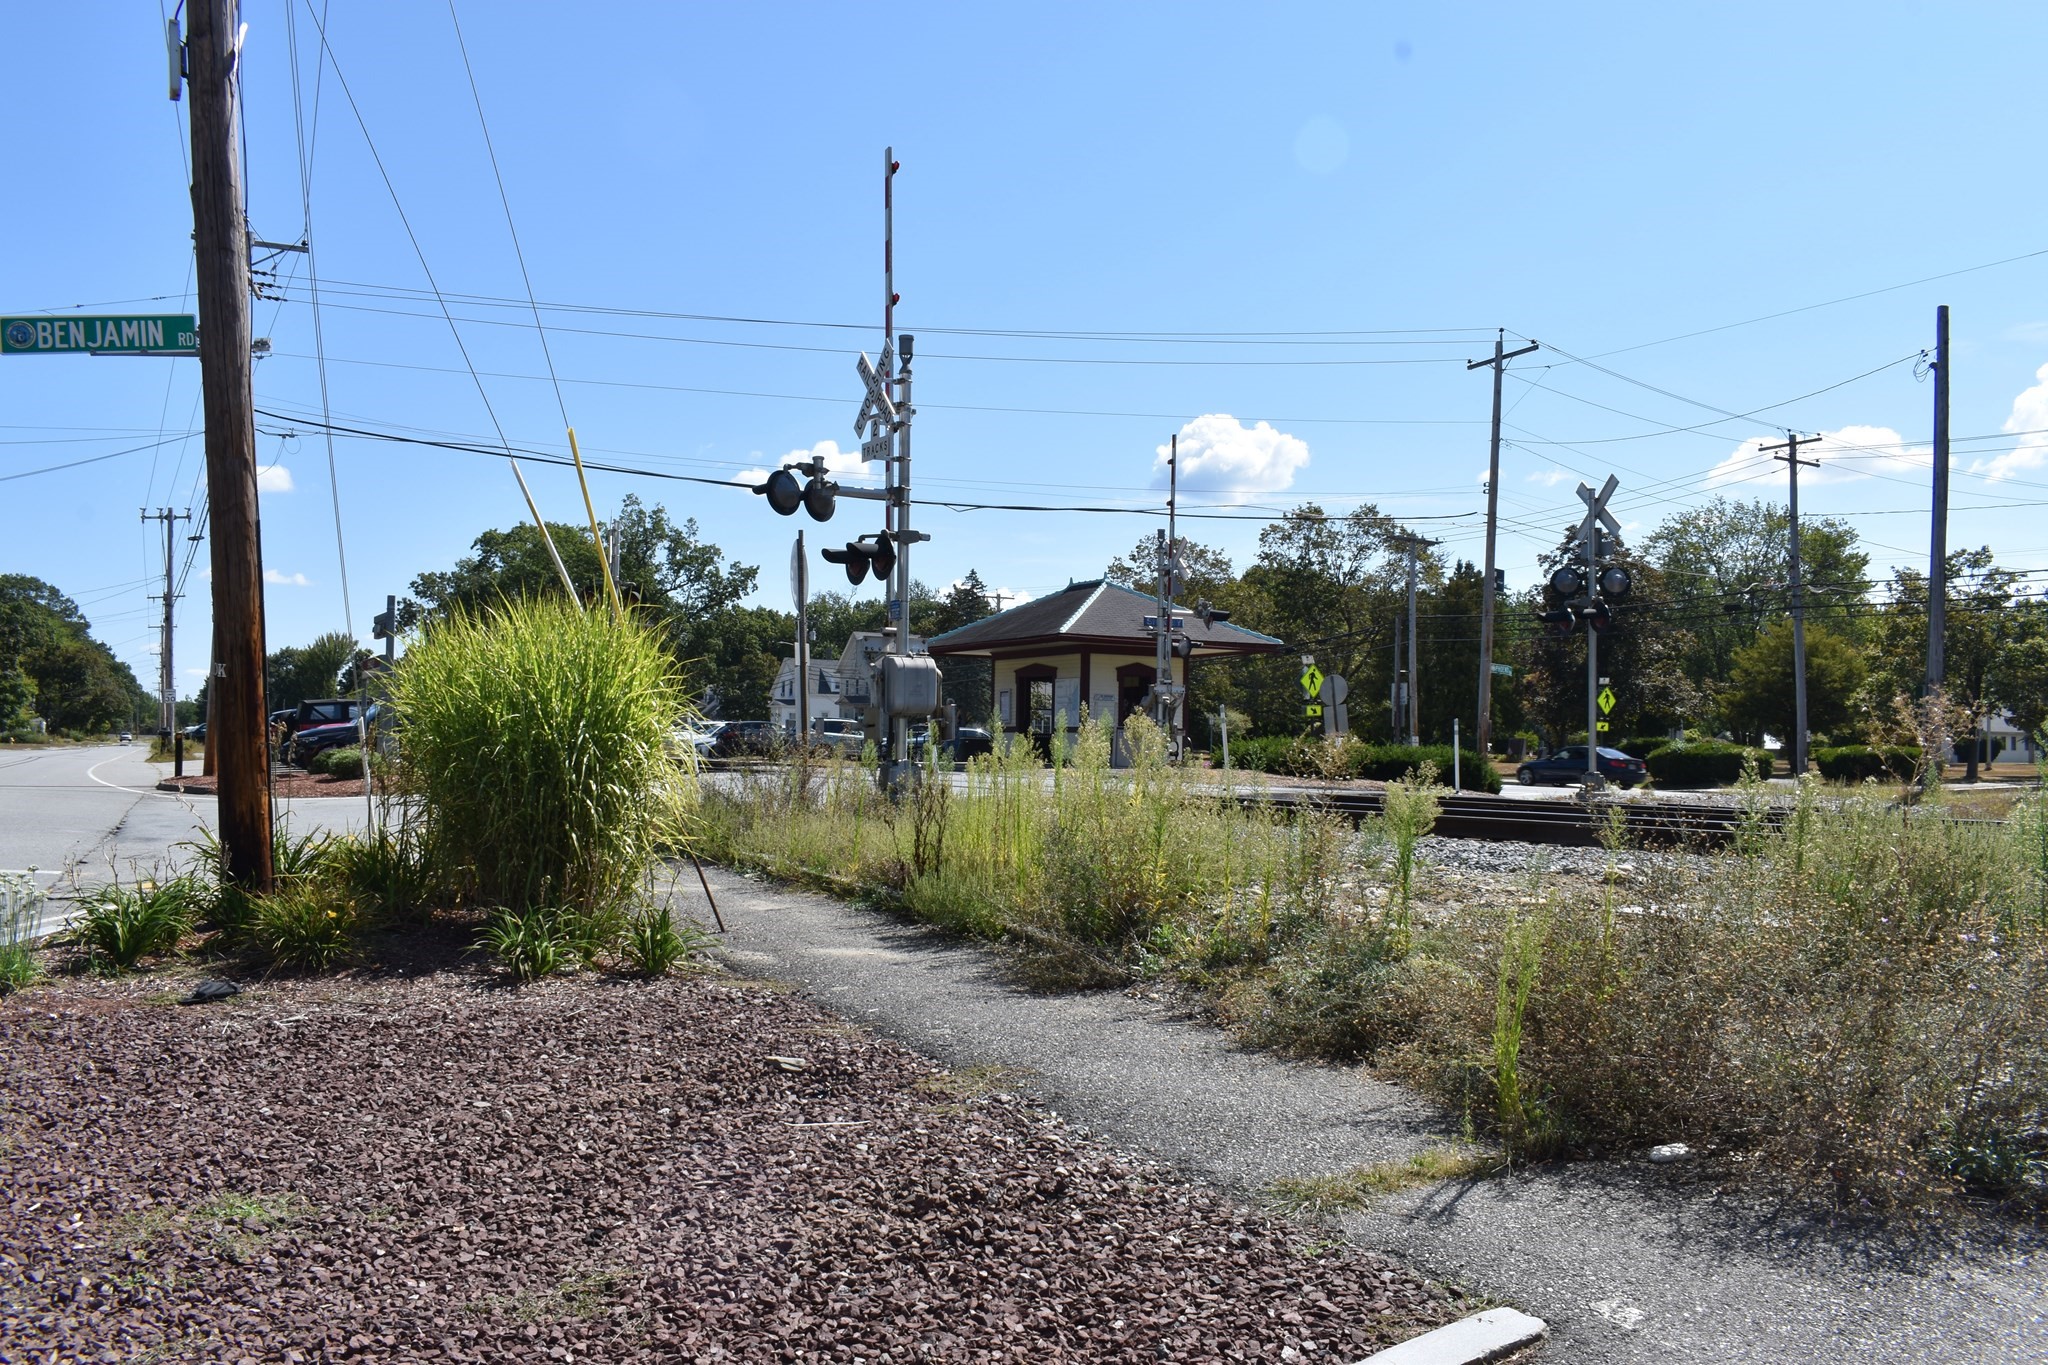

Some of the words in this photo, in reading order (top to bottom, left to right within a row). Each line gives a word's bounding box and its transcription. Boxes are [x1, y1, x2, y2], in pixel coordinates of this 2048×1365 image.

[36, 320, 164, 348] BENJAMIN
[178, 332, 194, 346] RD
[858, 359, 871, 387] RAIL
[857, 348, 889, 430] CROSSING
[877, 393, 891, 423] ROAD
[873, 424, 877, 436] 2
[862, 441, 887, 457] TRACKS
